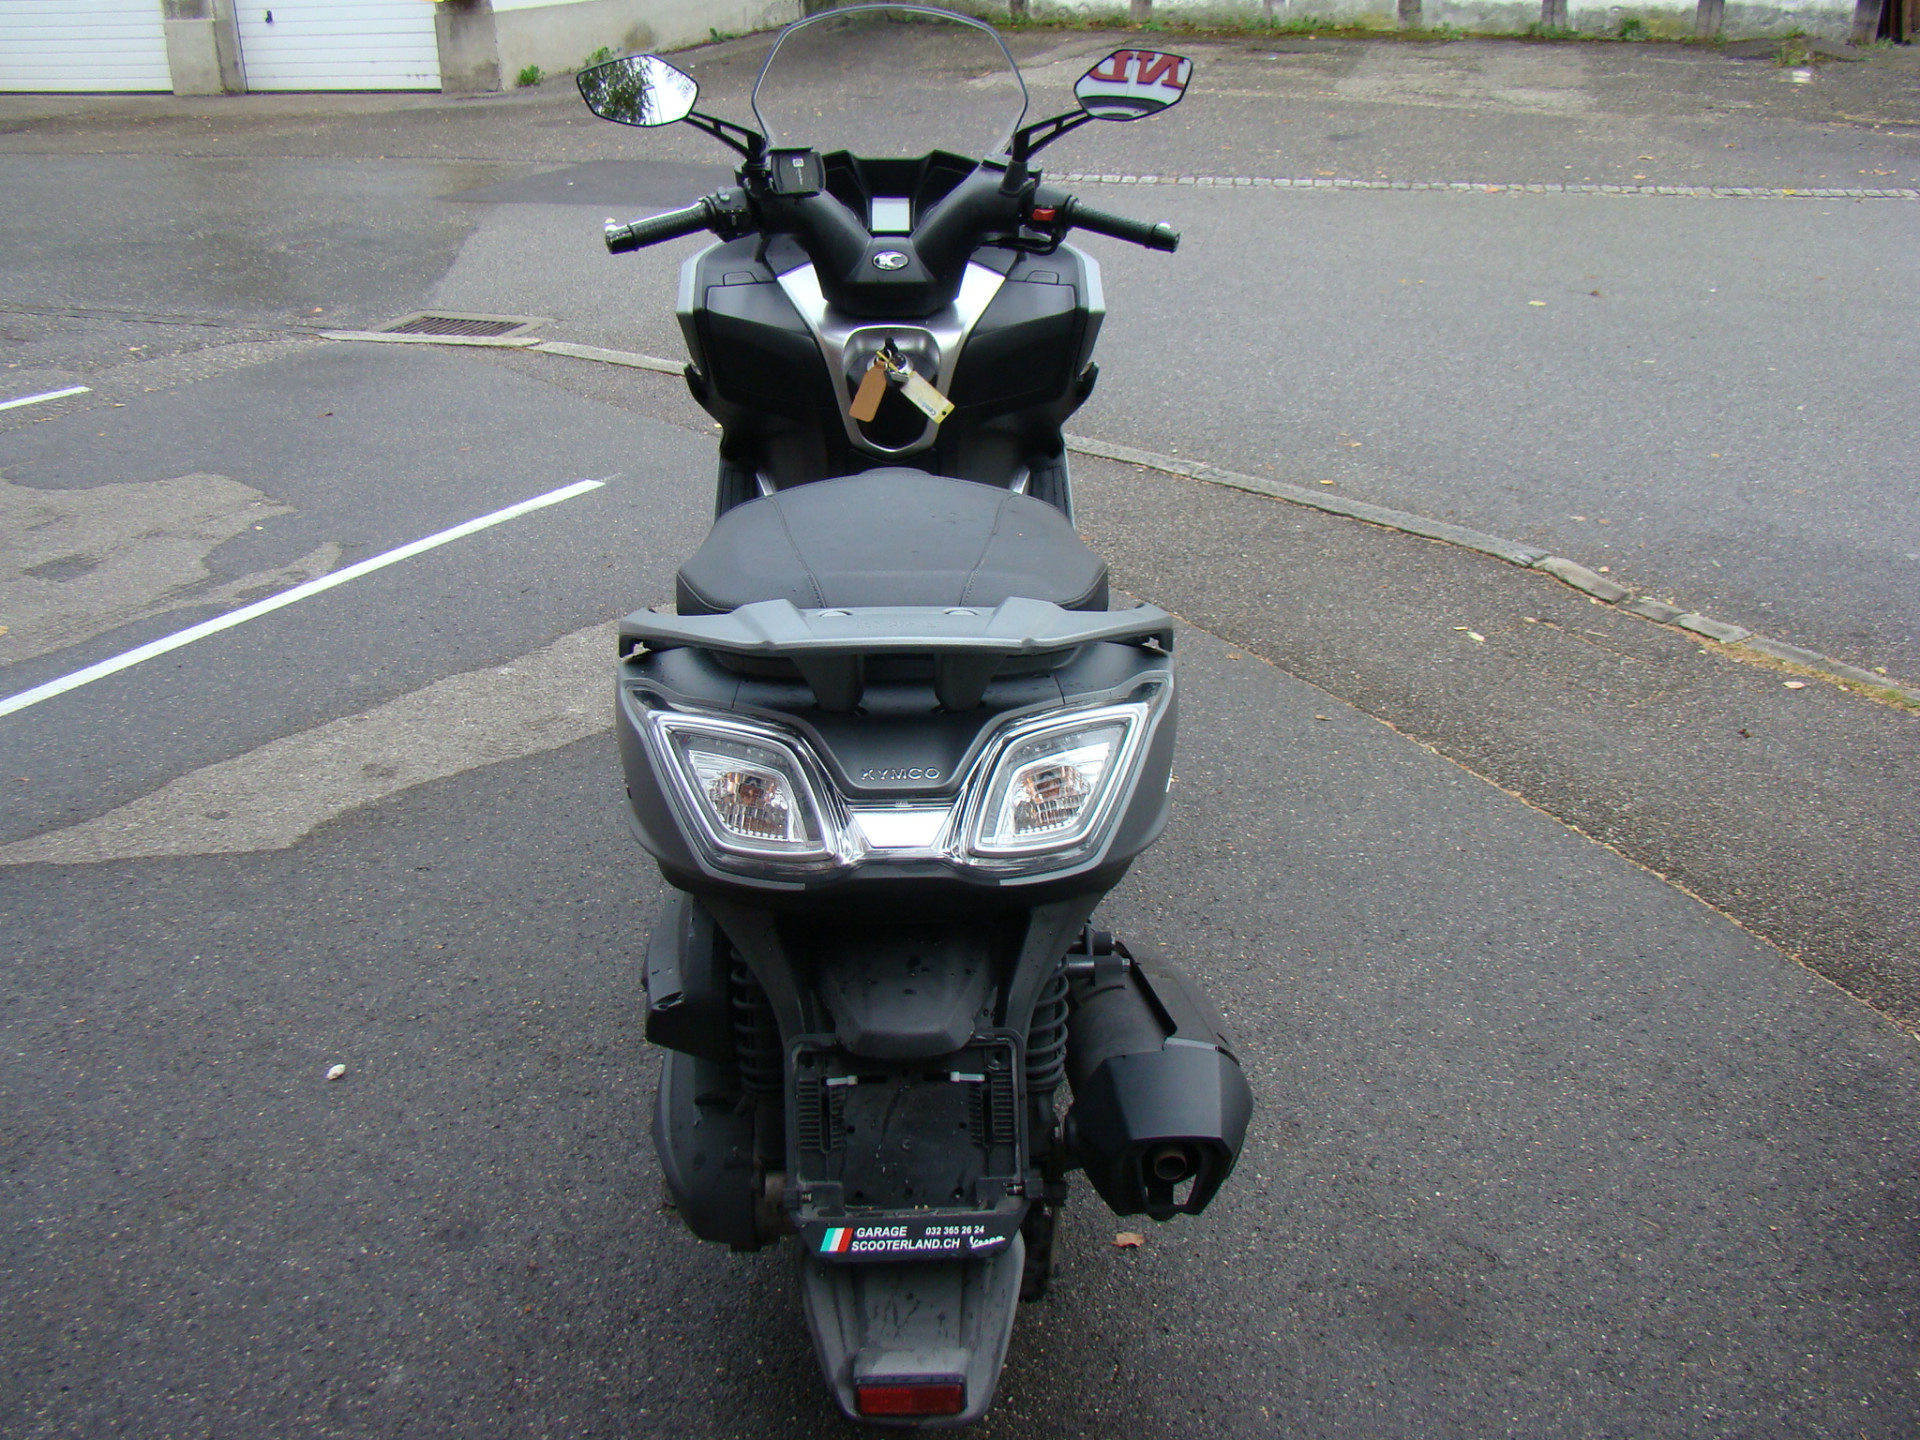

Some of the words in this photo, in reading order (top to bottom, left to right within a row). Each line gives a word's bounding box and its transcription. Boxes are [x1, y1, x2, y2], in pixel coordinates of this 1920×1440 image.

[861, 767, 940, 780] KYMCO
[856, 1226, 908, 1238] GARAGE
[925, 1226, 942, 1236] 032
[943, 1226, 960, 1235] 365
[961, 1225, 972, 1235] 26
[973, 1225, 985, 1234] 24
[851, 1238, 961, 1251] SCOOTERLAND.CH
